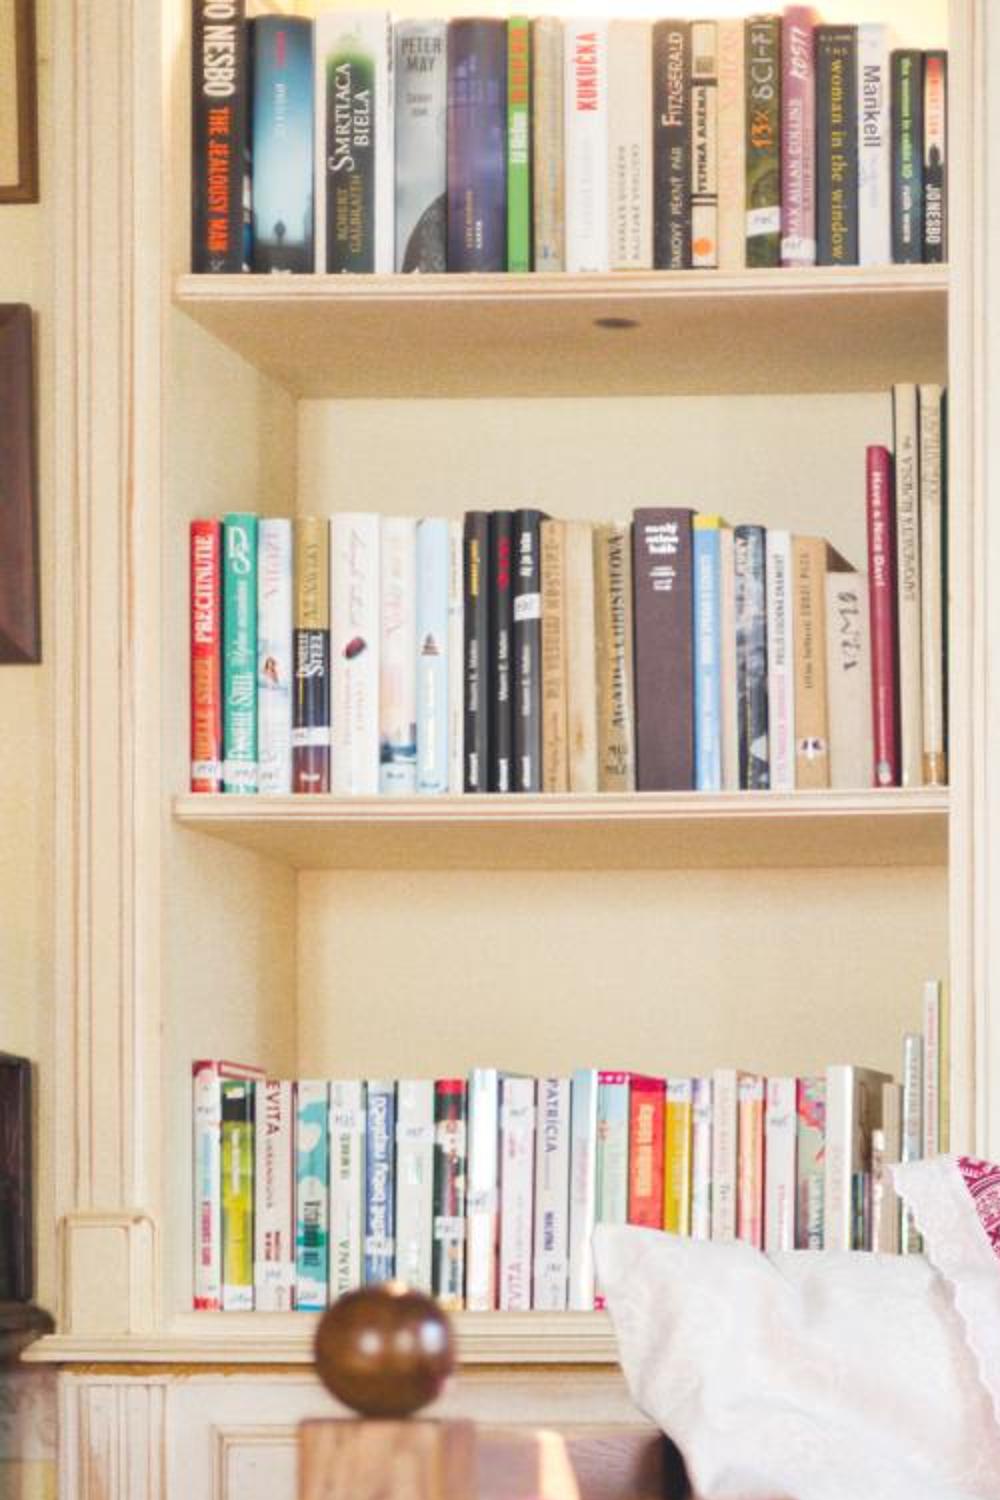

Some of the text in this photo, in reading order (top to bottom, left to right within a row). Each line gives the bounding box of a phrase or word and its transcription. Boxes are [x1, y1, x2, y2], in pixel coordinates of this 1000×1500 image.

[203, 0, 236, 97] O NESBO
[401, 37, 441, 55] PETER
[407, 56, 435, 73] MAY
[573, 32, 599, 111] KUKUČKA
[662, 32, 684, 127] FITZGERALD
[831, 59, 844, 123] woman
[863, 65, 881, 147] Mankell
[328, 64, 354, 173] SMRTIACA
[353, 90, 369, 147] BIELA
[831, 131, 847, 147] in
[208, 107, 230, 251] THE JEALOUSY MAN
[831, 154, 848, 181] the
[831, 189, 848, 259] window
[307, 633, 324, 677] STEEL
[266, 1079, 280, 1135] EVITA
